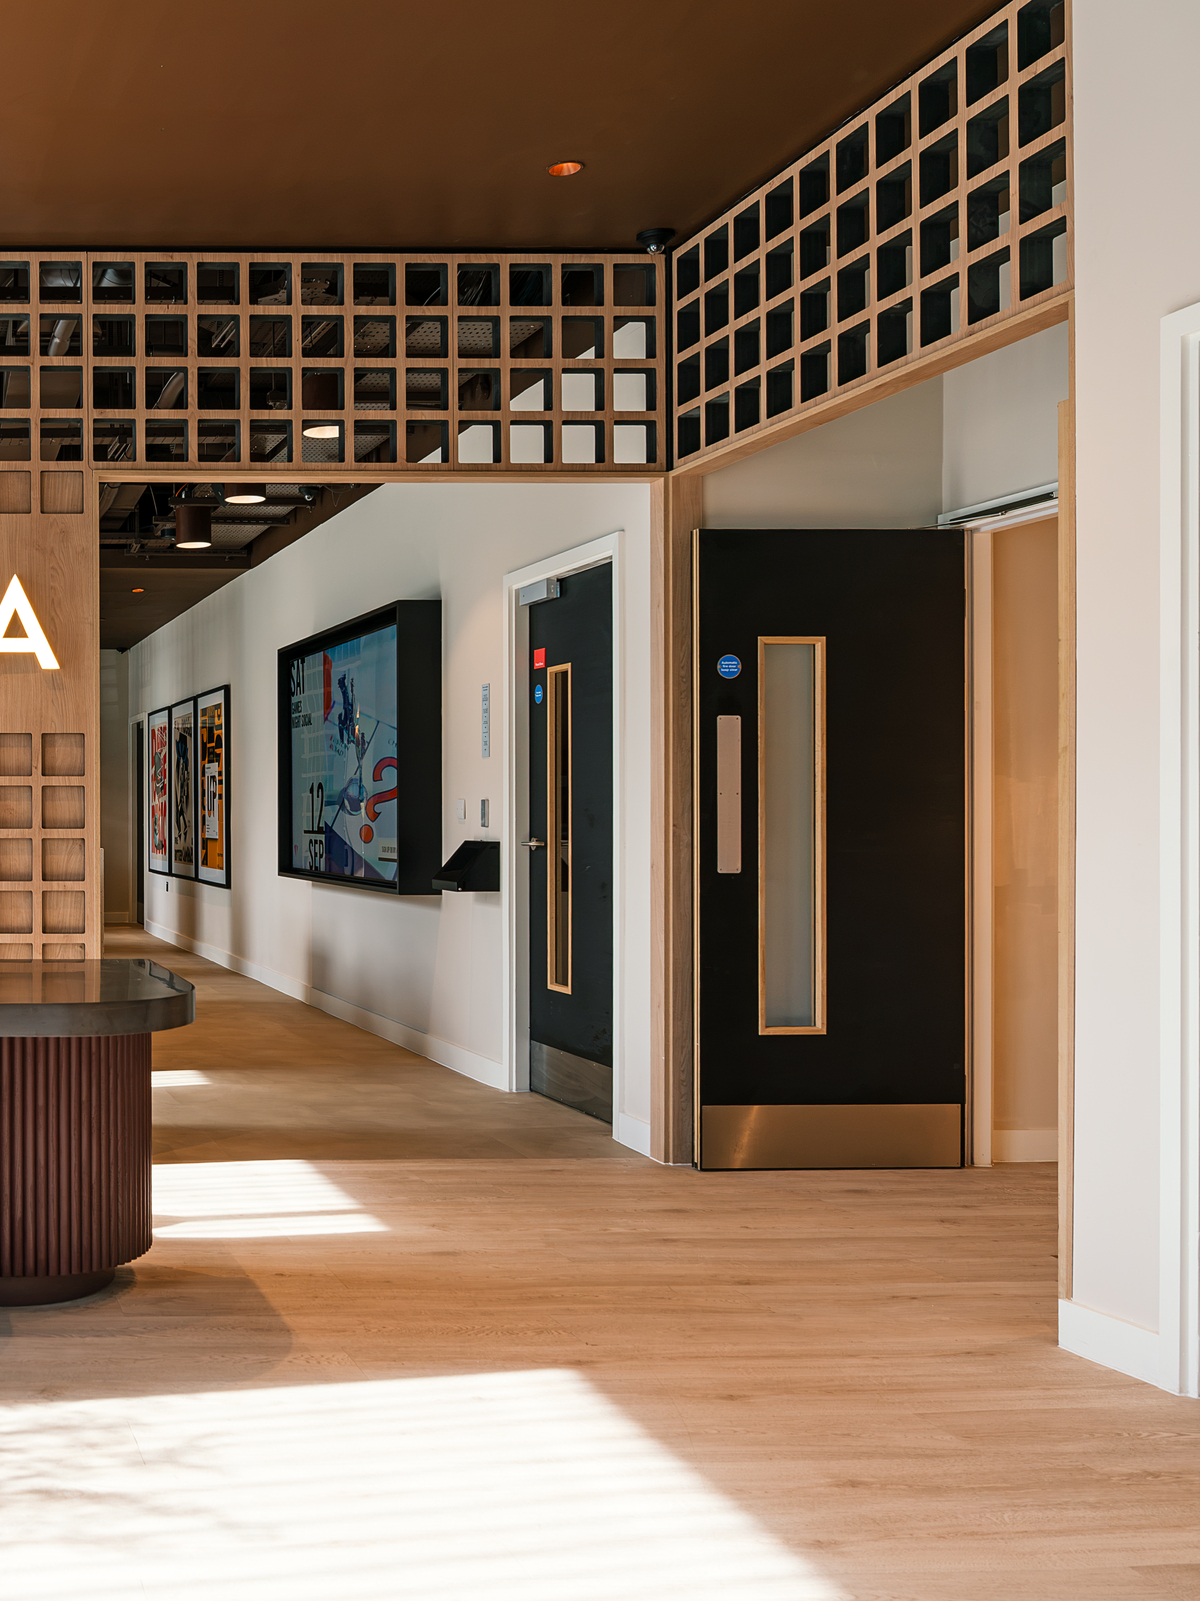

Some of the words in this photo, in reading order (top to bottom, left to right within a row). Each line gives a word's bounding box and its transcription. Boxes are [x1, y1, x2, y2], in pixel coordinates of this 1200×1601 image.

[290, 657, 306, 697] SAT
[309, 782, 324, 831] 12
[308, 838, 324, 871] SEP
